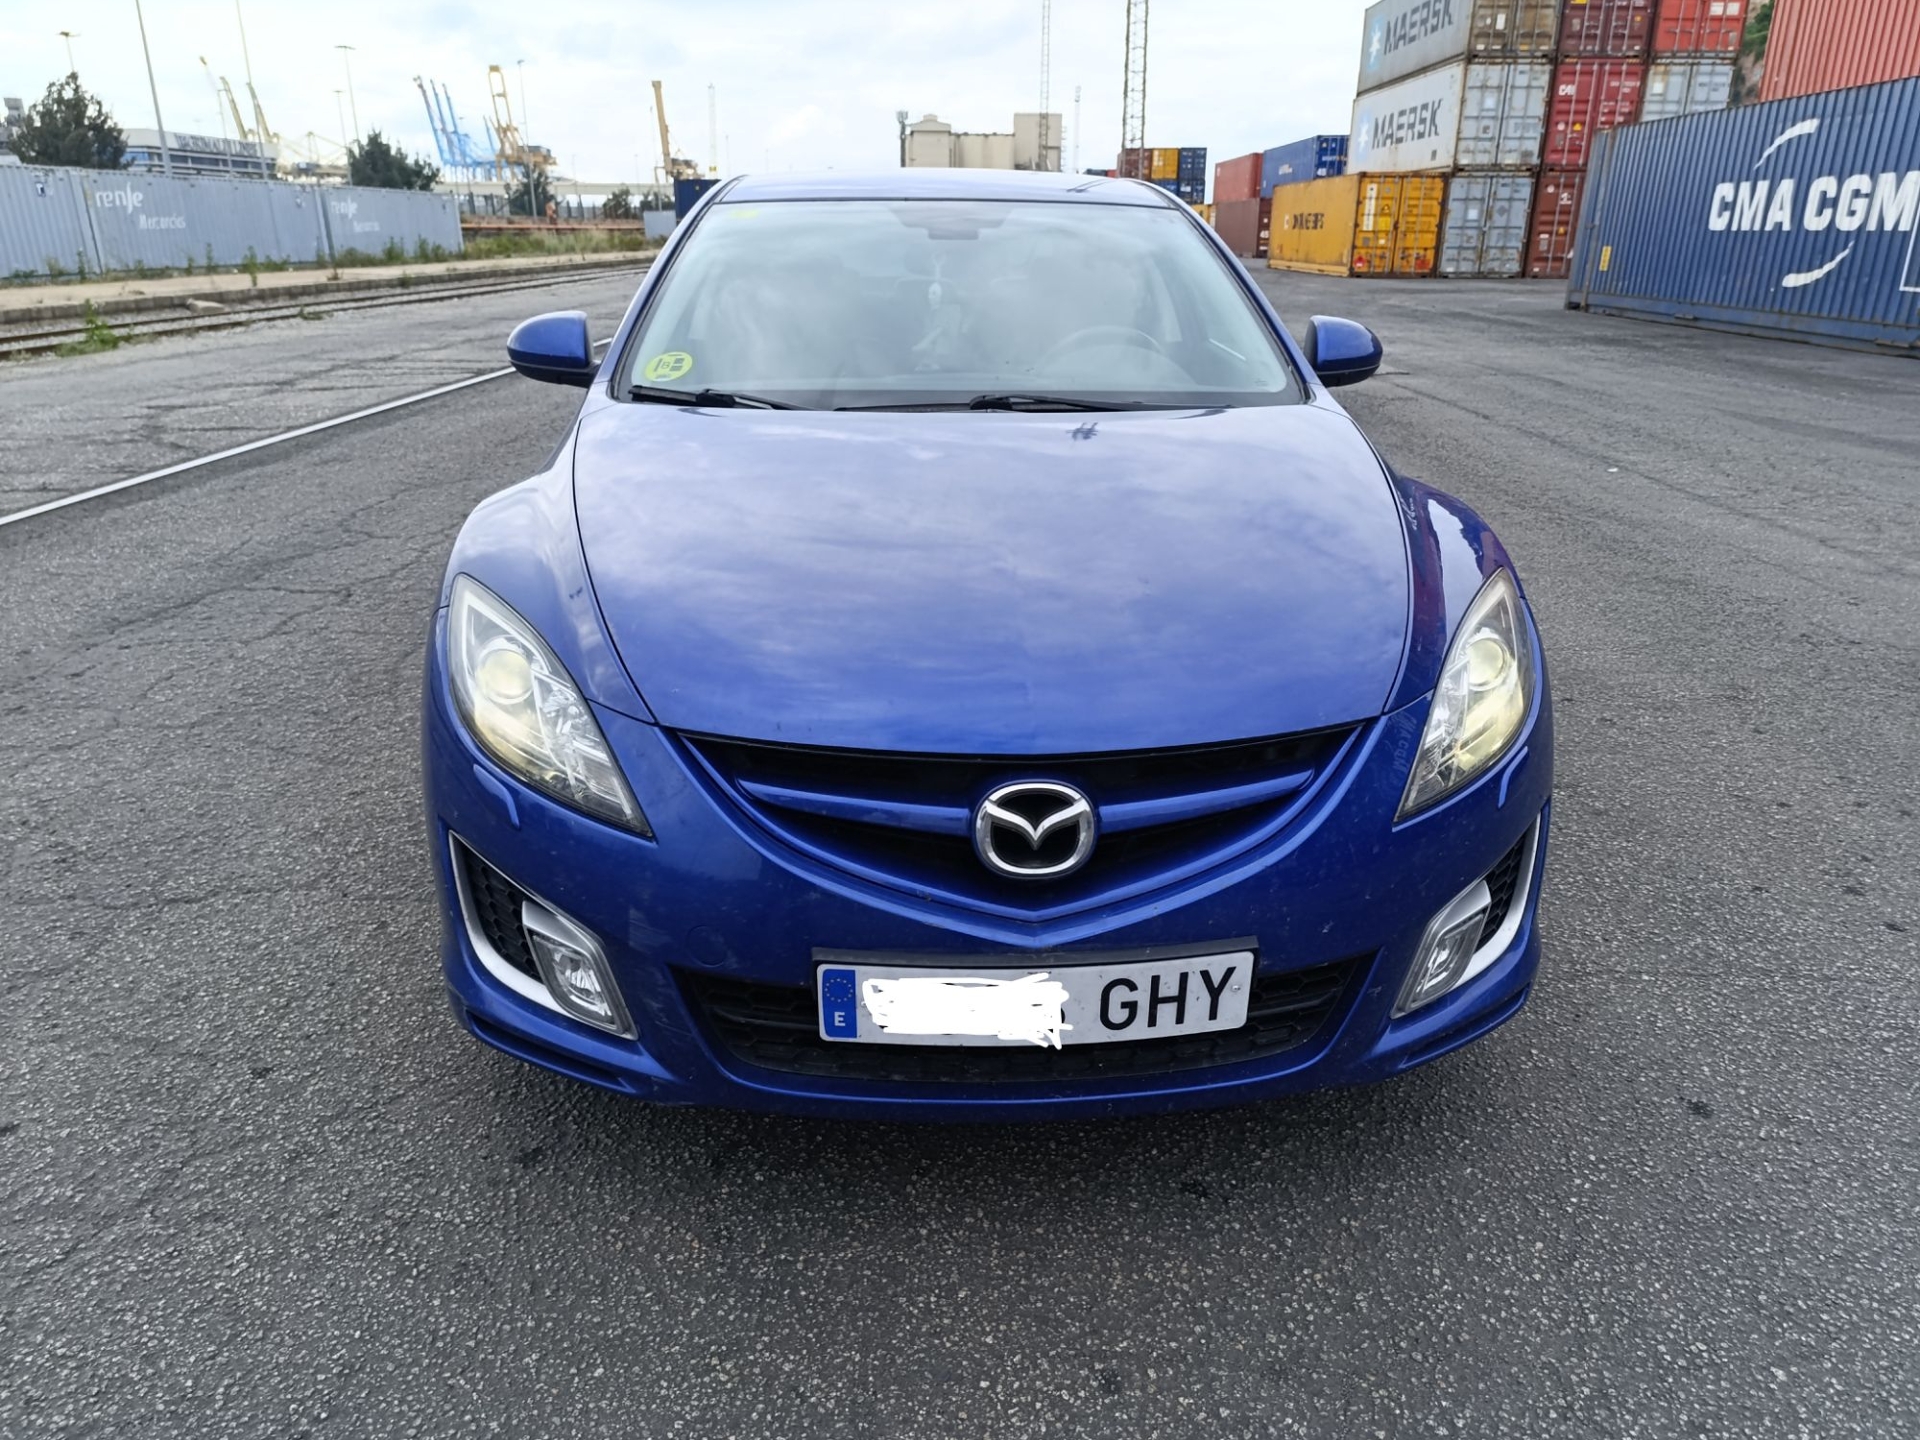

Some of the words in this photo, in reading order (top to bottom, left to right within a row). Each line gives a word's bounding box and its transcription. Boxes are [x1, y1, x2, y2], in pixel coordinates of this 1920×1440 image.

[1384, 0, 1453, 55] MAERSK
[1372, 98, 1443, 150] MAERSK
[96, 181, 143, 214] renfe
[1708, 178, 1795, 231] CMA
[1803, 170, 1920, 231] CGM
[834, 1012, 846, 1027] E
[1100, 966, 1237, 1031] GHY
